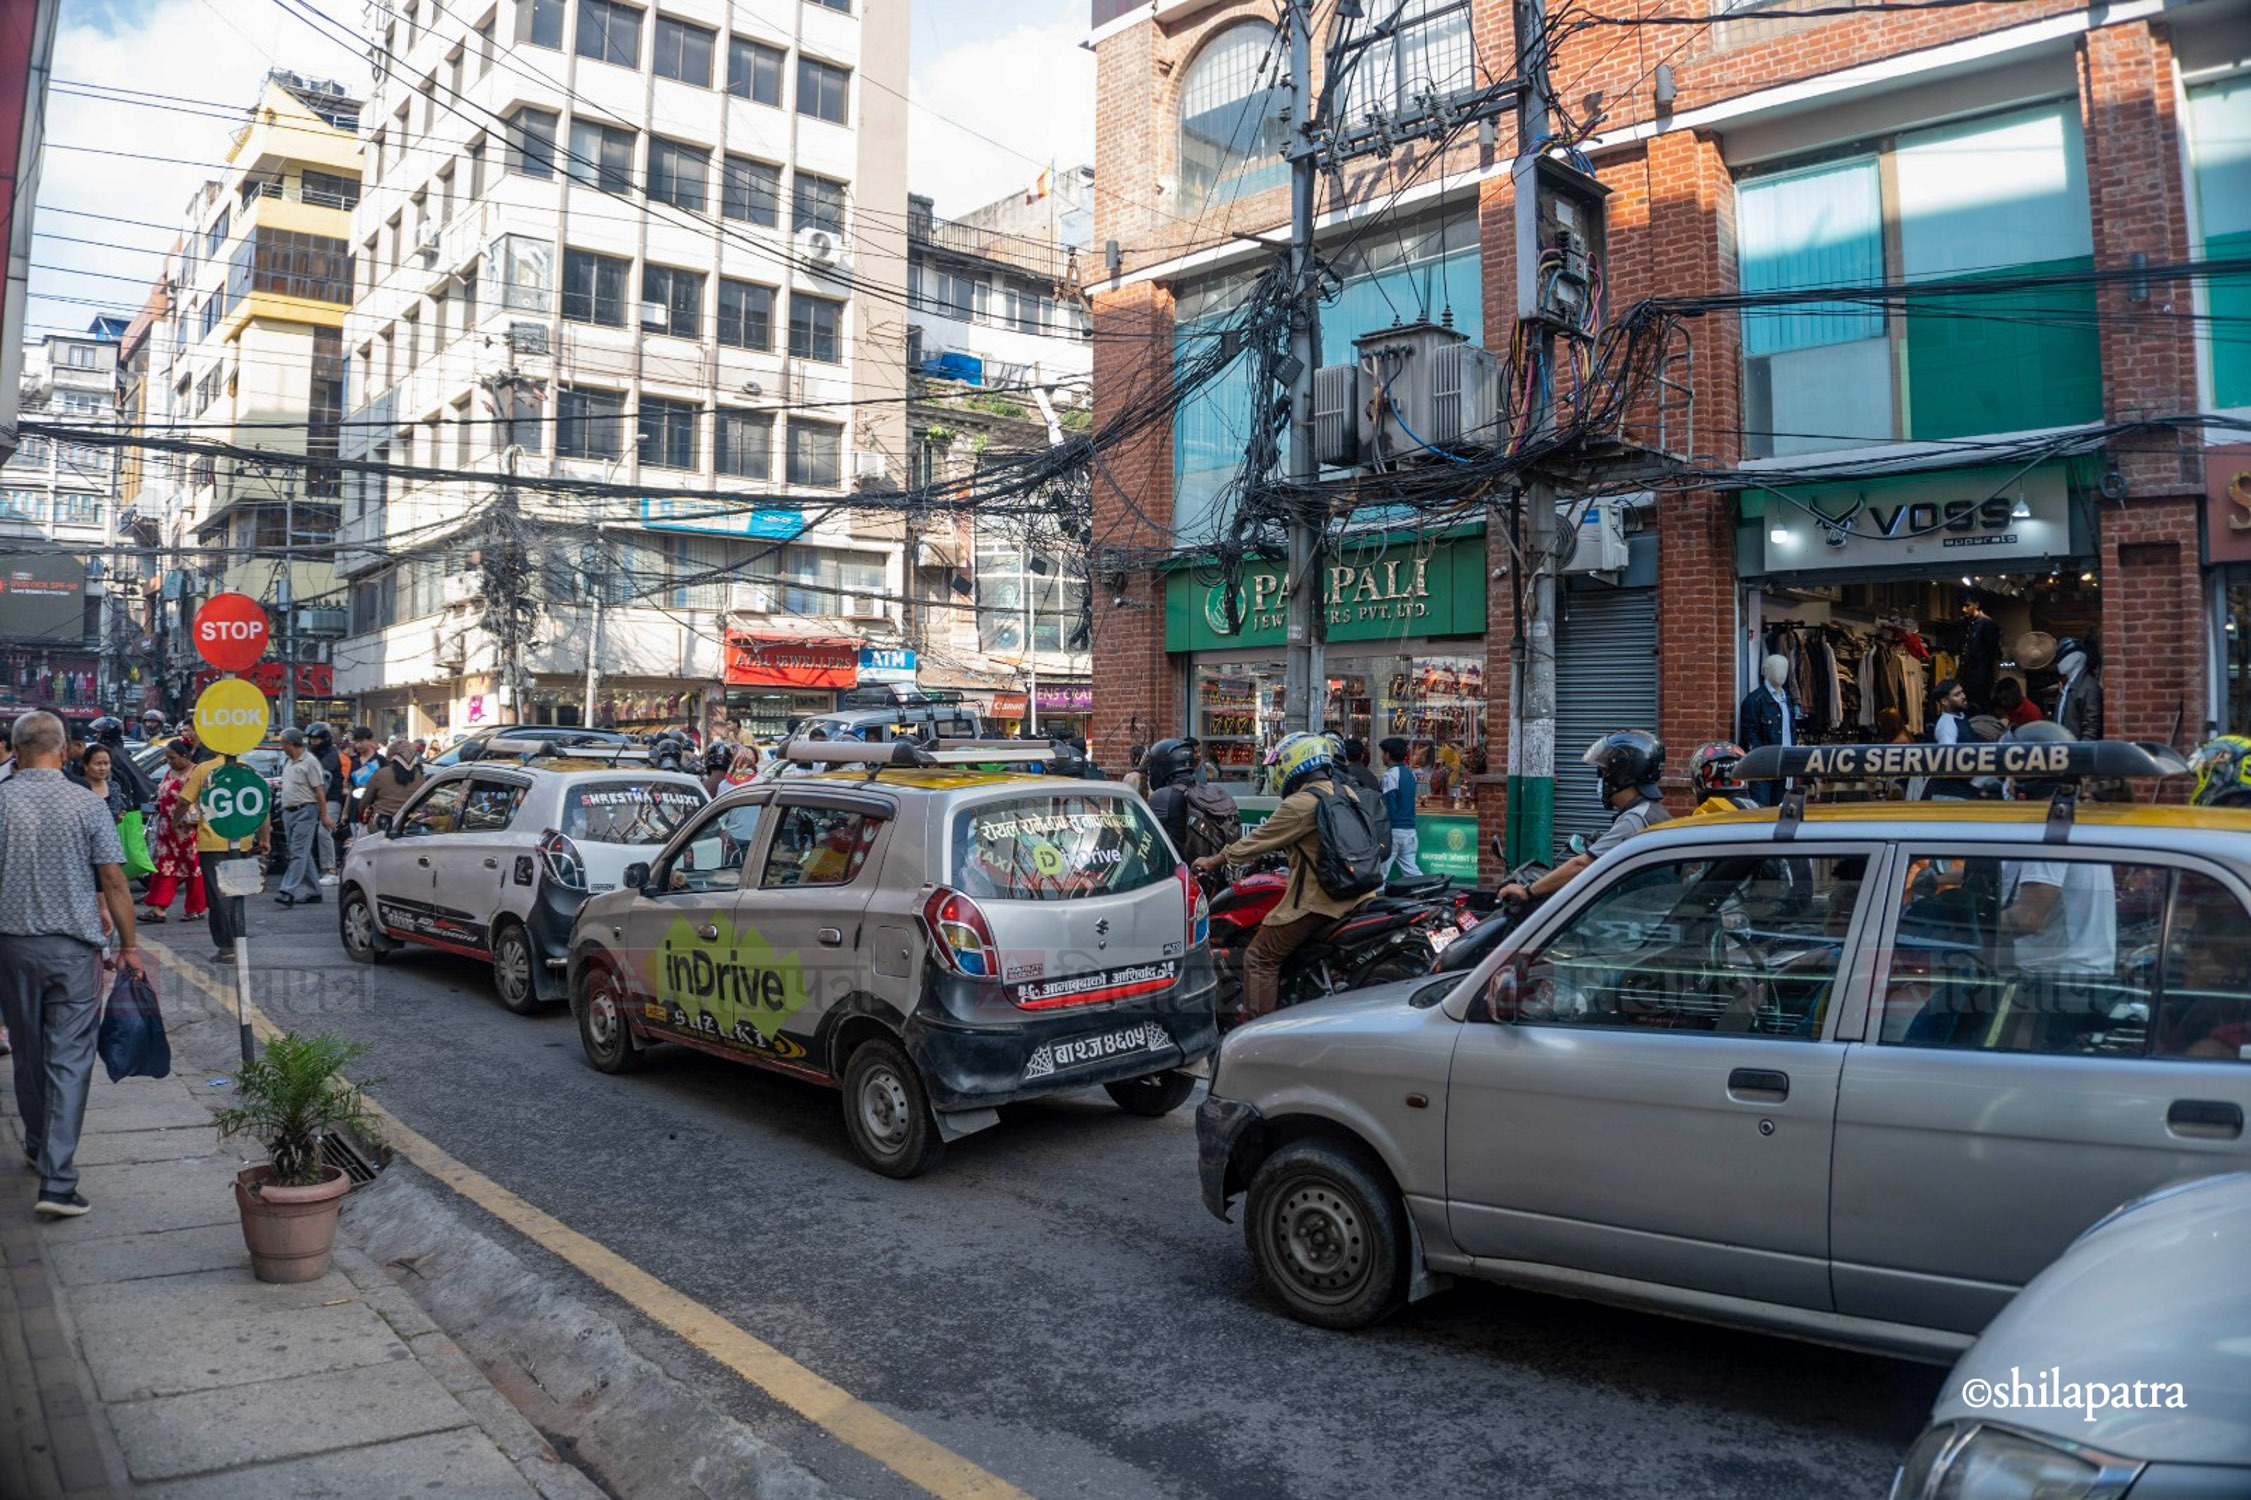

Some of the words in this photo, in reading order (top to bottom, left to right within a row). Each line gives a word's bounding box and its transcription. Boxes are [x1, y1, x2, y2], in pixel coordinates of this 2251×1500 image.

[1869, 498, 2012, 536] VOSS
[1253, 558, 1430, 611] PAPALI
[1359, 605, 1391, 620] PVT.
[1397, 602, 1430, 618] LTD.
[202, 622, 263, 640] STOP
[736, 652, 772, 667] ATAL
[776, 654, 852, 670] JEWELLERS
[872, 651, 906, 668] ATM
[993, 701, 1025, 710] Canon
[202, 709, 263, 726] LOOK
[1805, 748, 1855, 773] A/C
[1864, 747, 1996, 772] SERVICE
[2004, 745, 2069, 770] CAB
[208, 786, 263, 818] GO
[1137, 831, 1153, 859] TAXI
[665, 940, 785, 1012] inDrive
